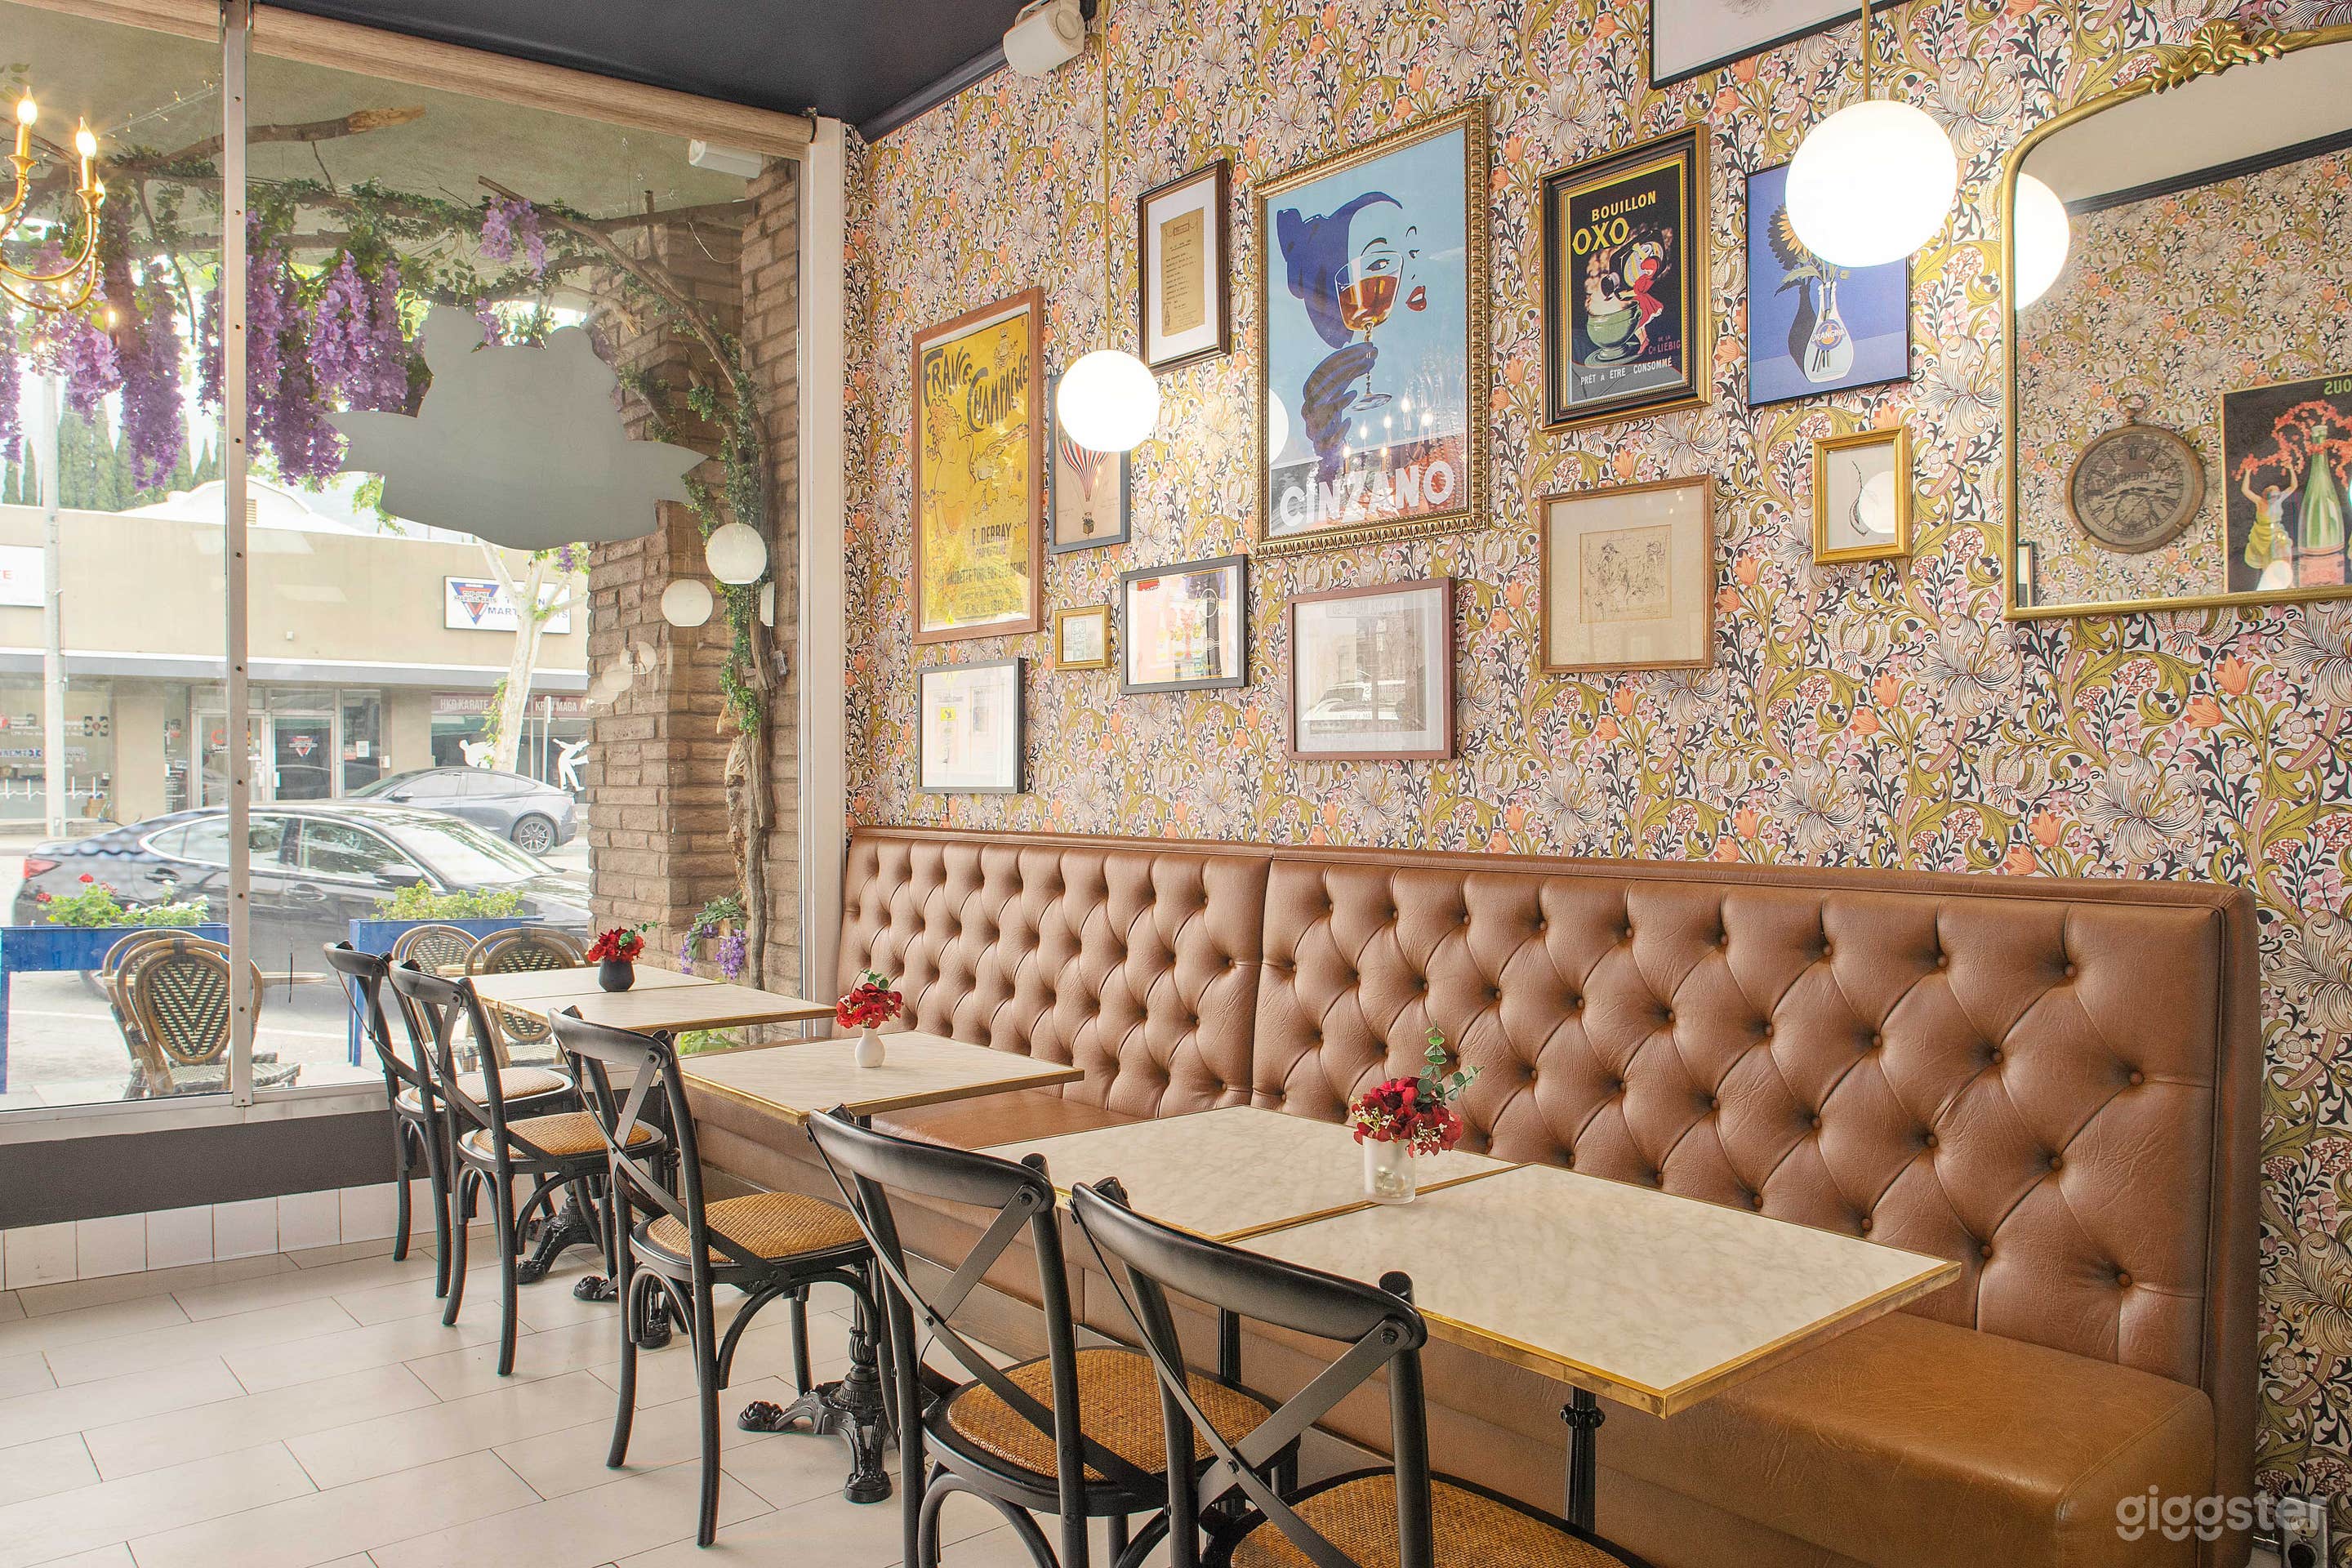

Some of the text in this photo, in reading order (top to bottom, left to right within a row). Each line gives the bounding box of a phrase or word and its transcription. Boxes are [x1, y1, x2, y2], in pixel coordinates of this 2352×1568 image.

[1592, 190, 1656, 221] BOUILLON
[1572, 216, 1630, 255] OXO
[1633, 355, 1673, 374] CONSOMMÉ
[967, 353, 1028, 433] CHAMPAGNE
[1280, 460, 1454, 527] CINZANO
[458, 699, 489, 711] KARATE
[555, 701, 577, 712] MAGA
